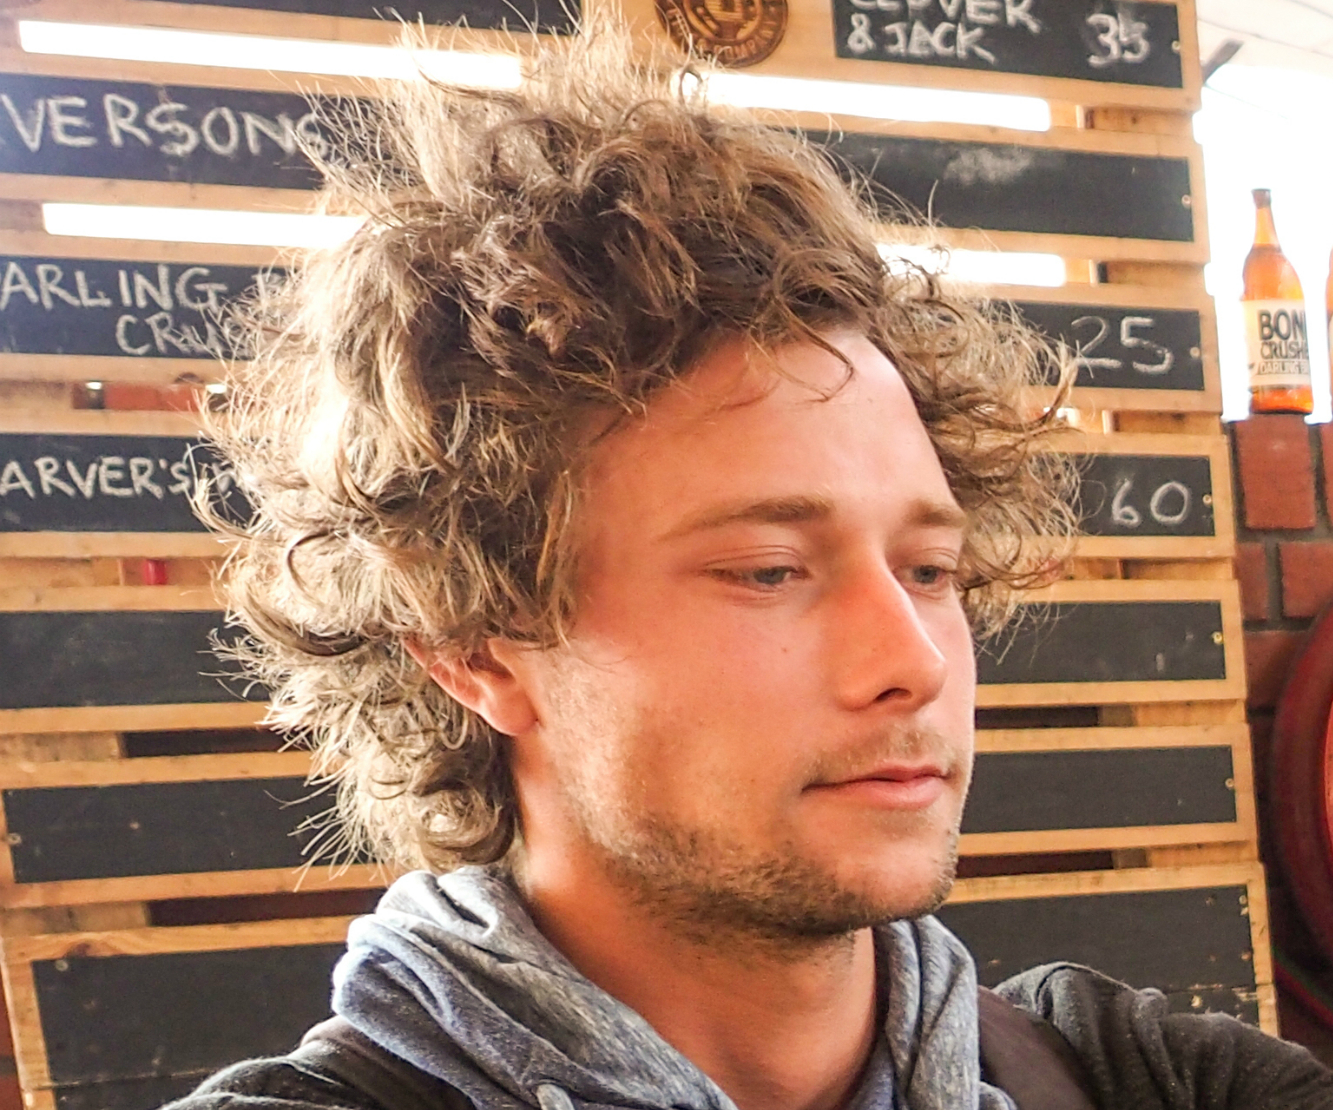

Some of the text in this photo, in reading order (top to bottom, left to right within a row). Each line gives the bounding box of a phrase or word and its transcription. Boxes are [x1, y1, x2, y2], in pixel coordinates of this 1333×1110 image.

[883, 19, 998, 65] JACK
[0, 91, 329, 158] VERSONS
[0, 261, 228, 311] ARLING
[1071, 315, 1174, 375] 25
[0, 456, 193, 500] ARVER'S
[1111, 477, 1192, 528] 60
